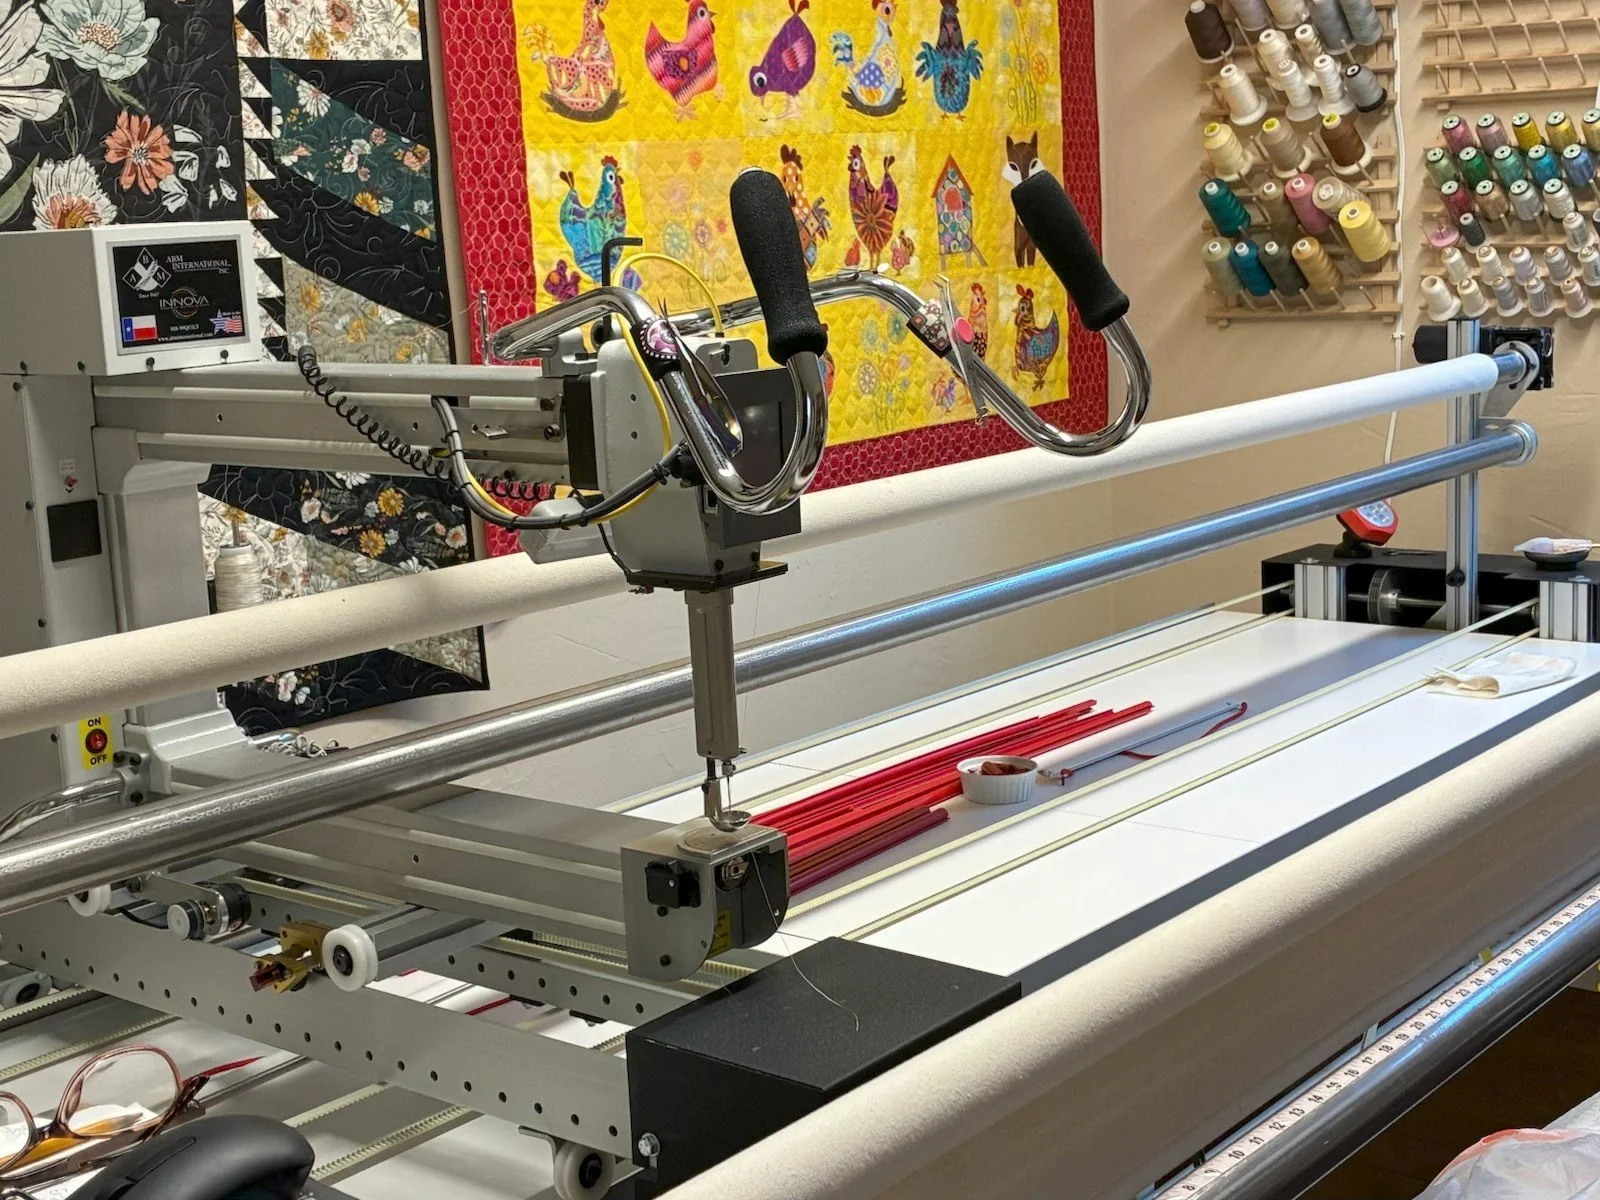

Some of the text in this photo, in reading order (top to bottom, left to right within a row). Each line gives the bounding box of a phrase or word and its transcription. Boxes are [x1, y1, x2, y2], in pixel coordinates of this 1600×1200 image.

[160, 296, 209, 308] INNOVA
[88, 717, 101, 727] ON
[91, 755, 107, 765] OFF
[1182, 1184, 1195, 1192] 8
[1204, 1168, 1217, 1177] 9
[1228, 1150, 1245, 1159] 10
[1249, 1136, 1265, 1146] 11
[1268, 1122, 1286, 1132] 12
[1288, 1107, 1305, 1118] 13
[1308, 1094, 1324, 1104] 14
[1343, 1068, 1360, 1079] 16
[1361, 1056, 1376, 1066] 17
[1379, 1044, 1394, 1054] 18
[1395, 1033, 1410, 1042] 19
[1409, 1021, 1426, 1031] 20
[1425, 1010, 1441, 1020] 21
[1455, 988, 1471, 998] 23
[1470, 978, 1485, 987] 24
[1484, 967, 1499, 977] 25
